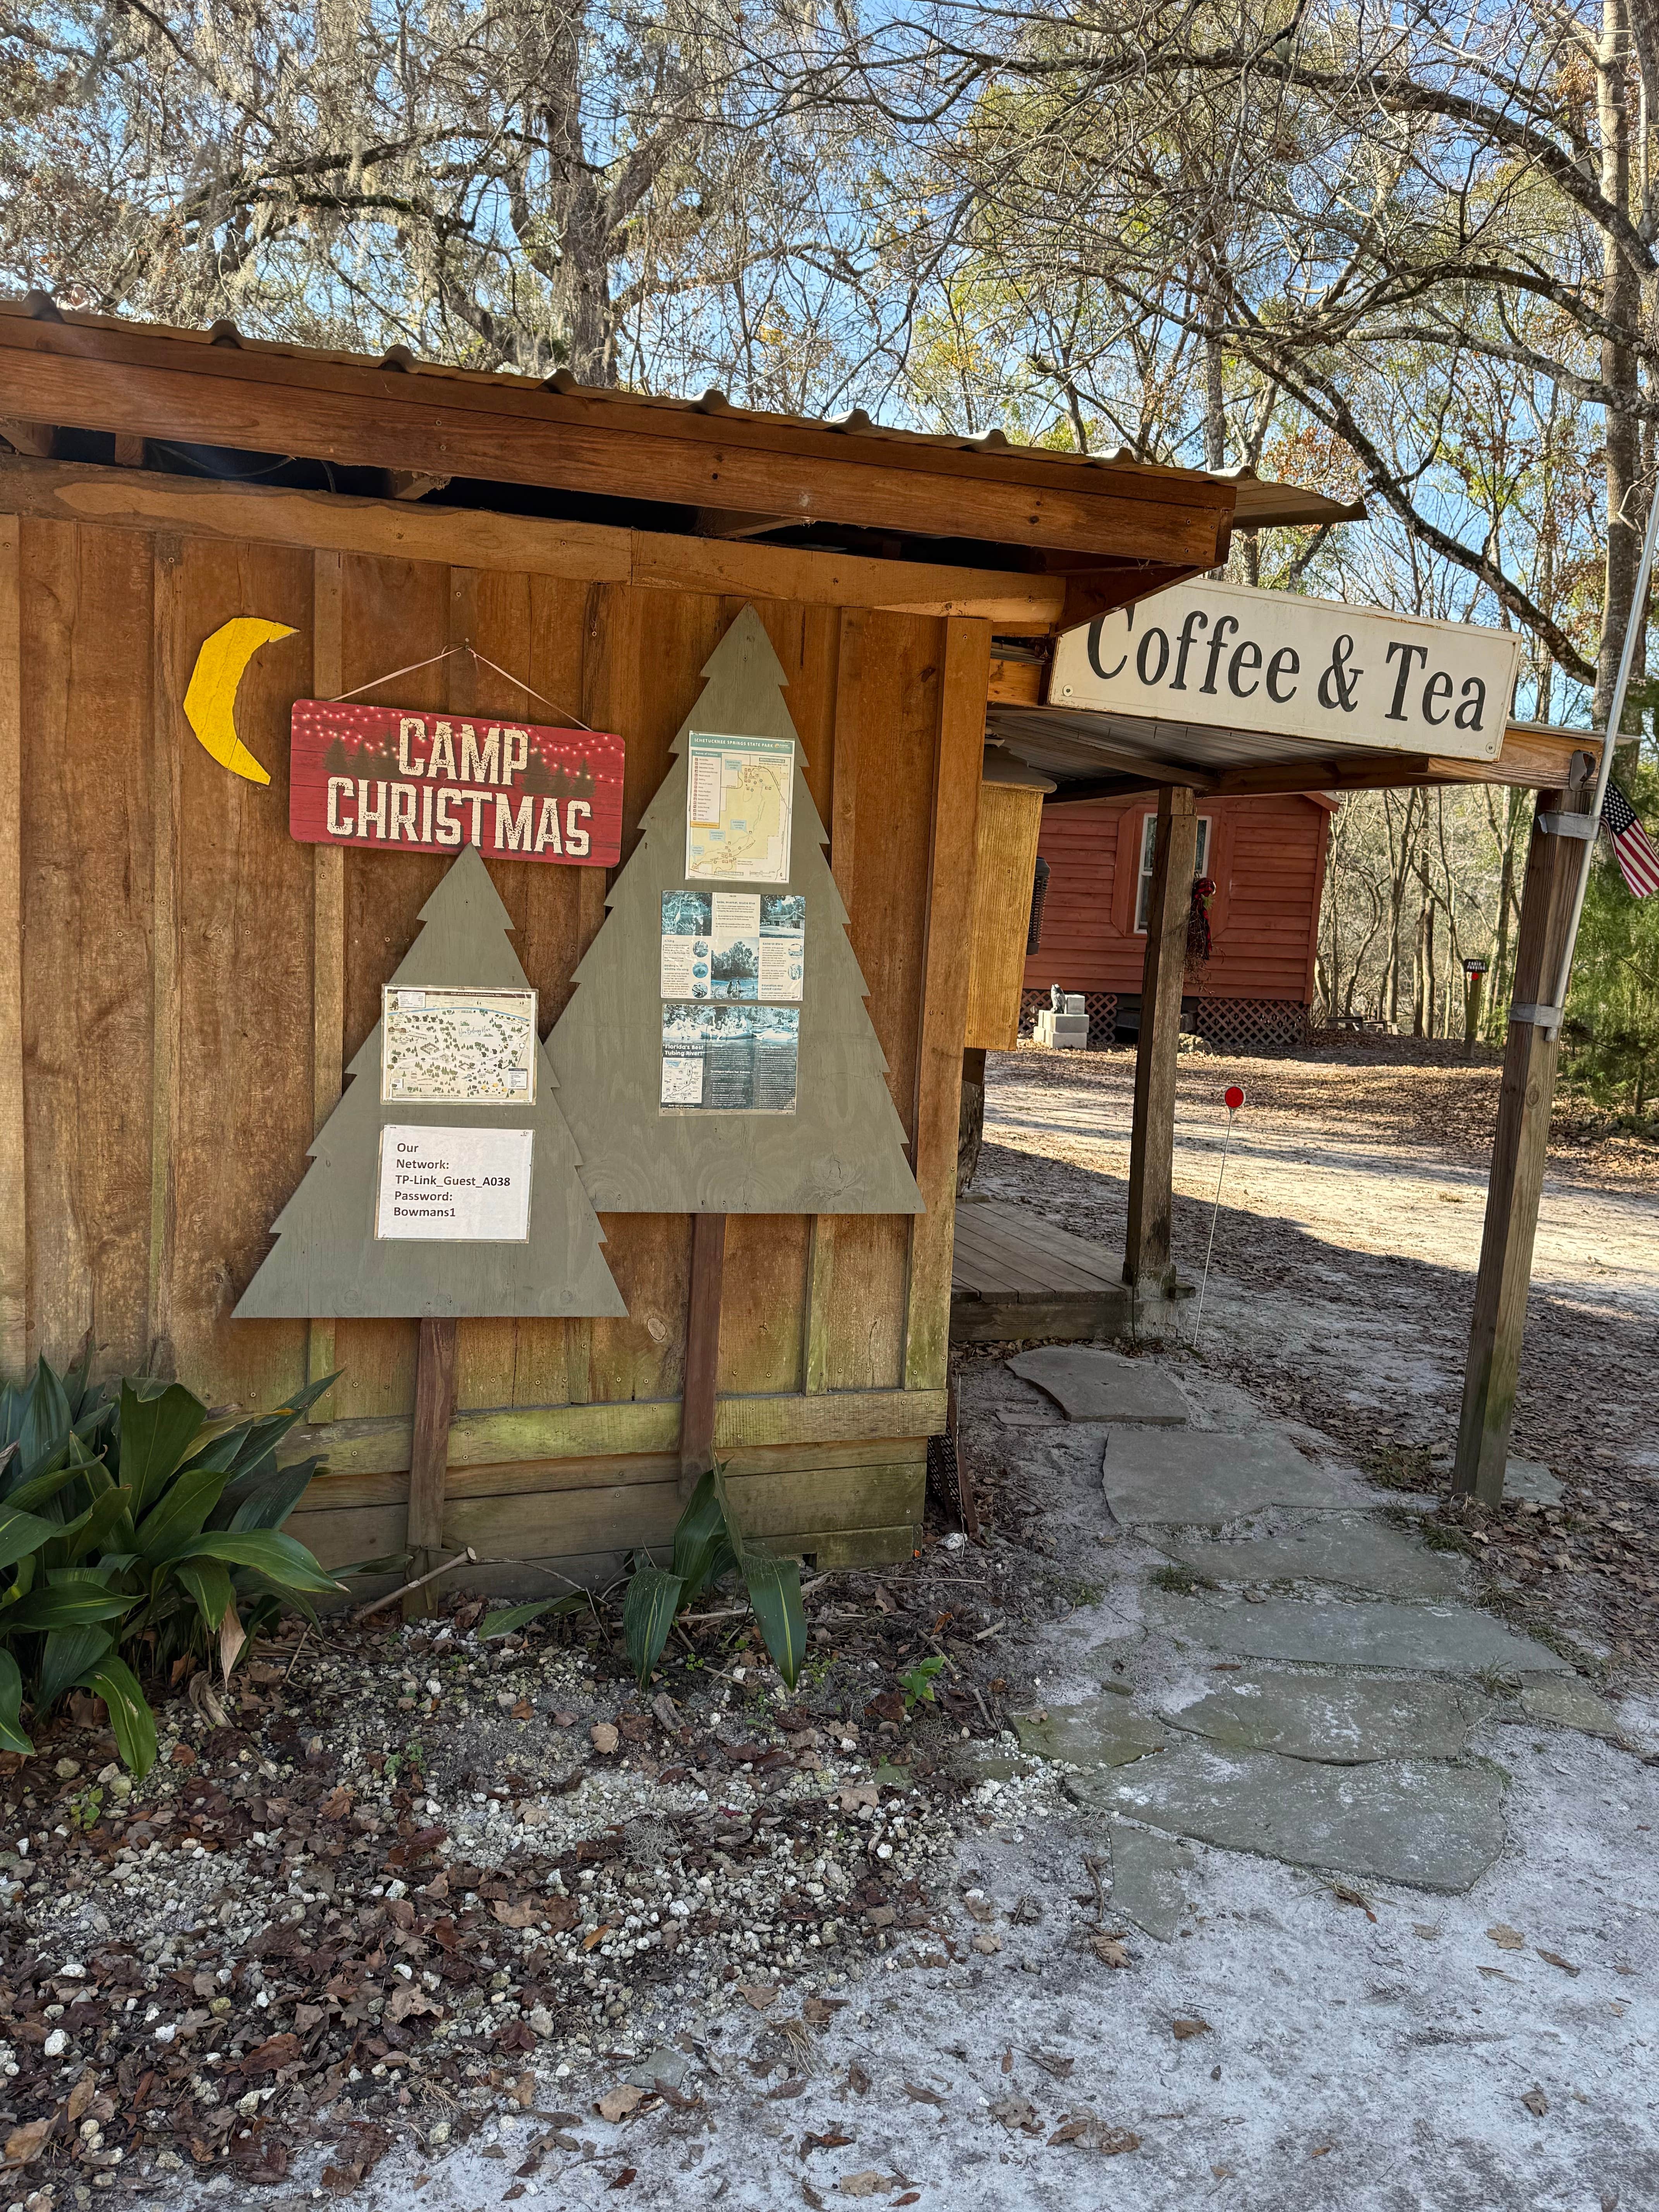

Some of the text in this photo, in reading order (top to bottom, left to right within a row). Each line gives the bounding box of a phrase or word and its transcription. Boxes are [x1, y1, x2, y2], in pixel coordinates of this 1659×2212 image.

[1087, 603, 1486, 731] Coffee & Tea
[398, 717, 529, 786] CAMP
[327, 777, 592, 855] CHRISTMAS
[397, 1143, 419, 1152] Our
[396, 1159, 449, 1169] Network:
[395, 1175, 510, 1188] TP-Link_Guest_A038
[395, 1191, 453, 1201] Password:
[393, 1207, 456, 1217] Bowmans1
